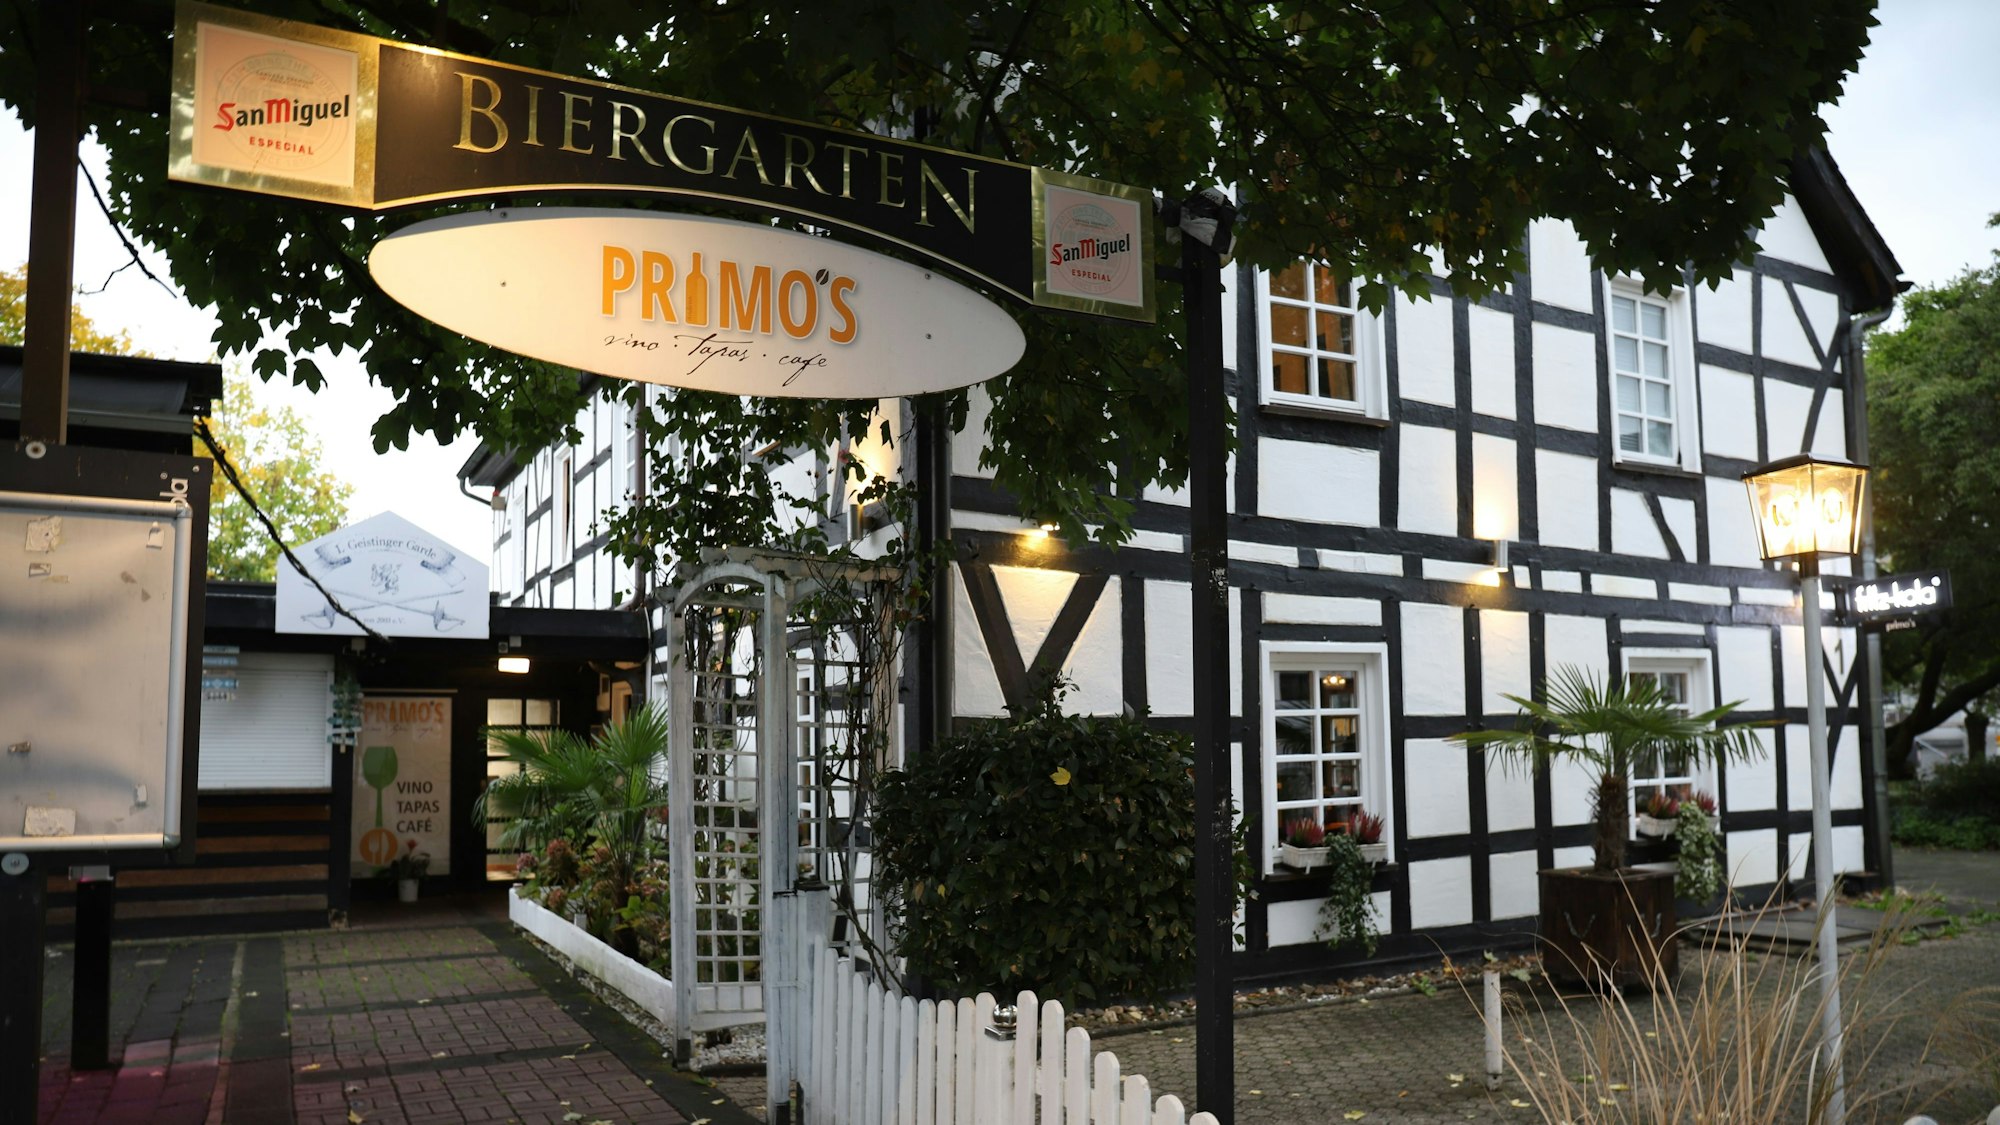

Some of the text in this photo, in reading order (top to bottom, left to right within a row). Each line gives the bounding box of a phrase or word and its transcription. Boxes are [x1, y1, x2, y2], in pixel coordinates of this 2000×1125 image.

[249, 136, 315, 156] ESPECIAL
[453, 71, 980, 235] BIERGARTEN
[1071, 268, 1112, 282] ESPECIAL
[600, 244, 858, 345] PRIMO'S
[604, 333, 660, 351] vino
[347, 536, 404, 550] Geistinger
[406, 539, 437, 559] Garde
[1854, 577, 1938, 613] fritz-kola
[1834, 638, 1844, 676] 1
[364, 701, 445, 724] PRIMO'S
[397, 781, 433, 795] VINO
[397, 800, 440, 814] TAPAS
[396, 817, 432, 833] CAFÉ
